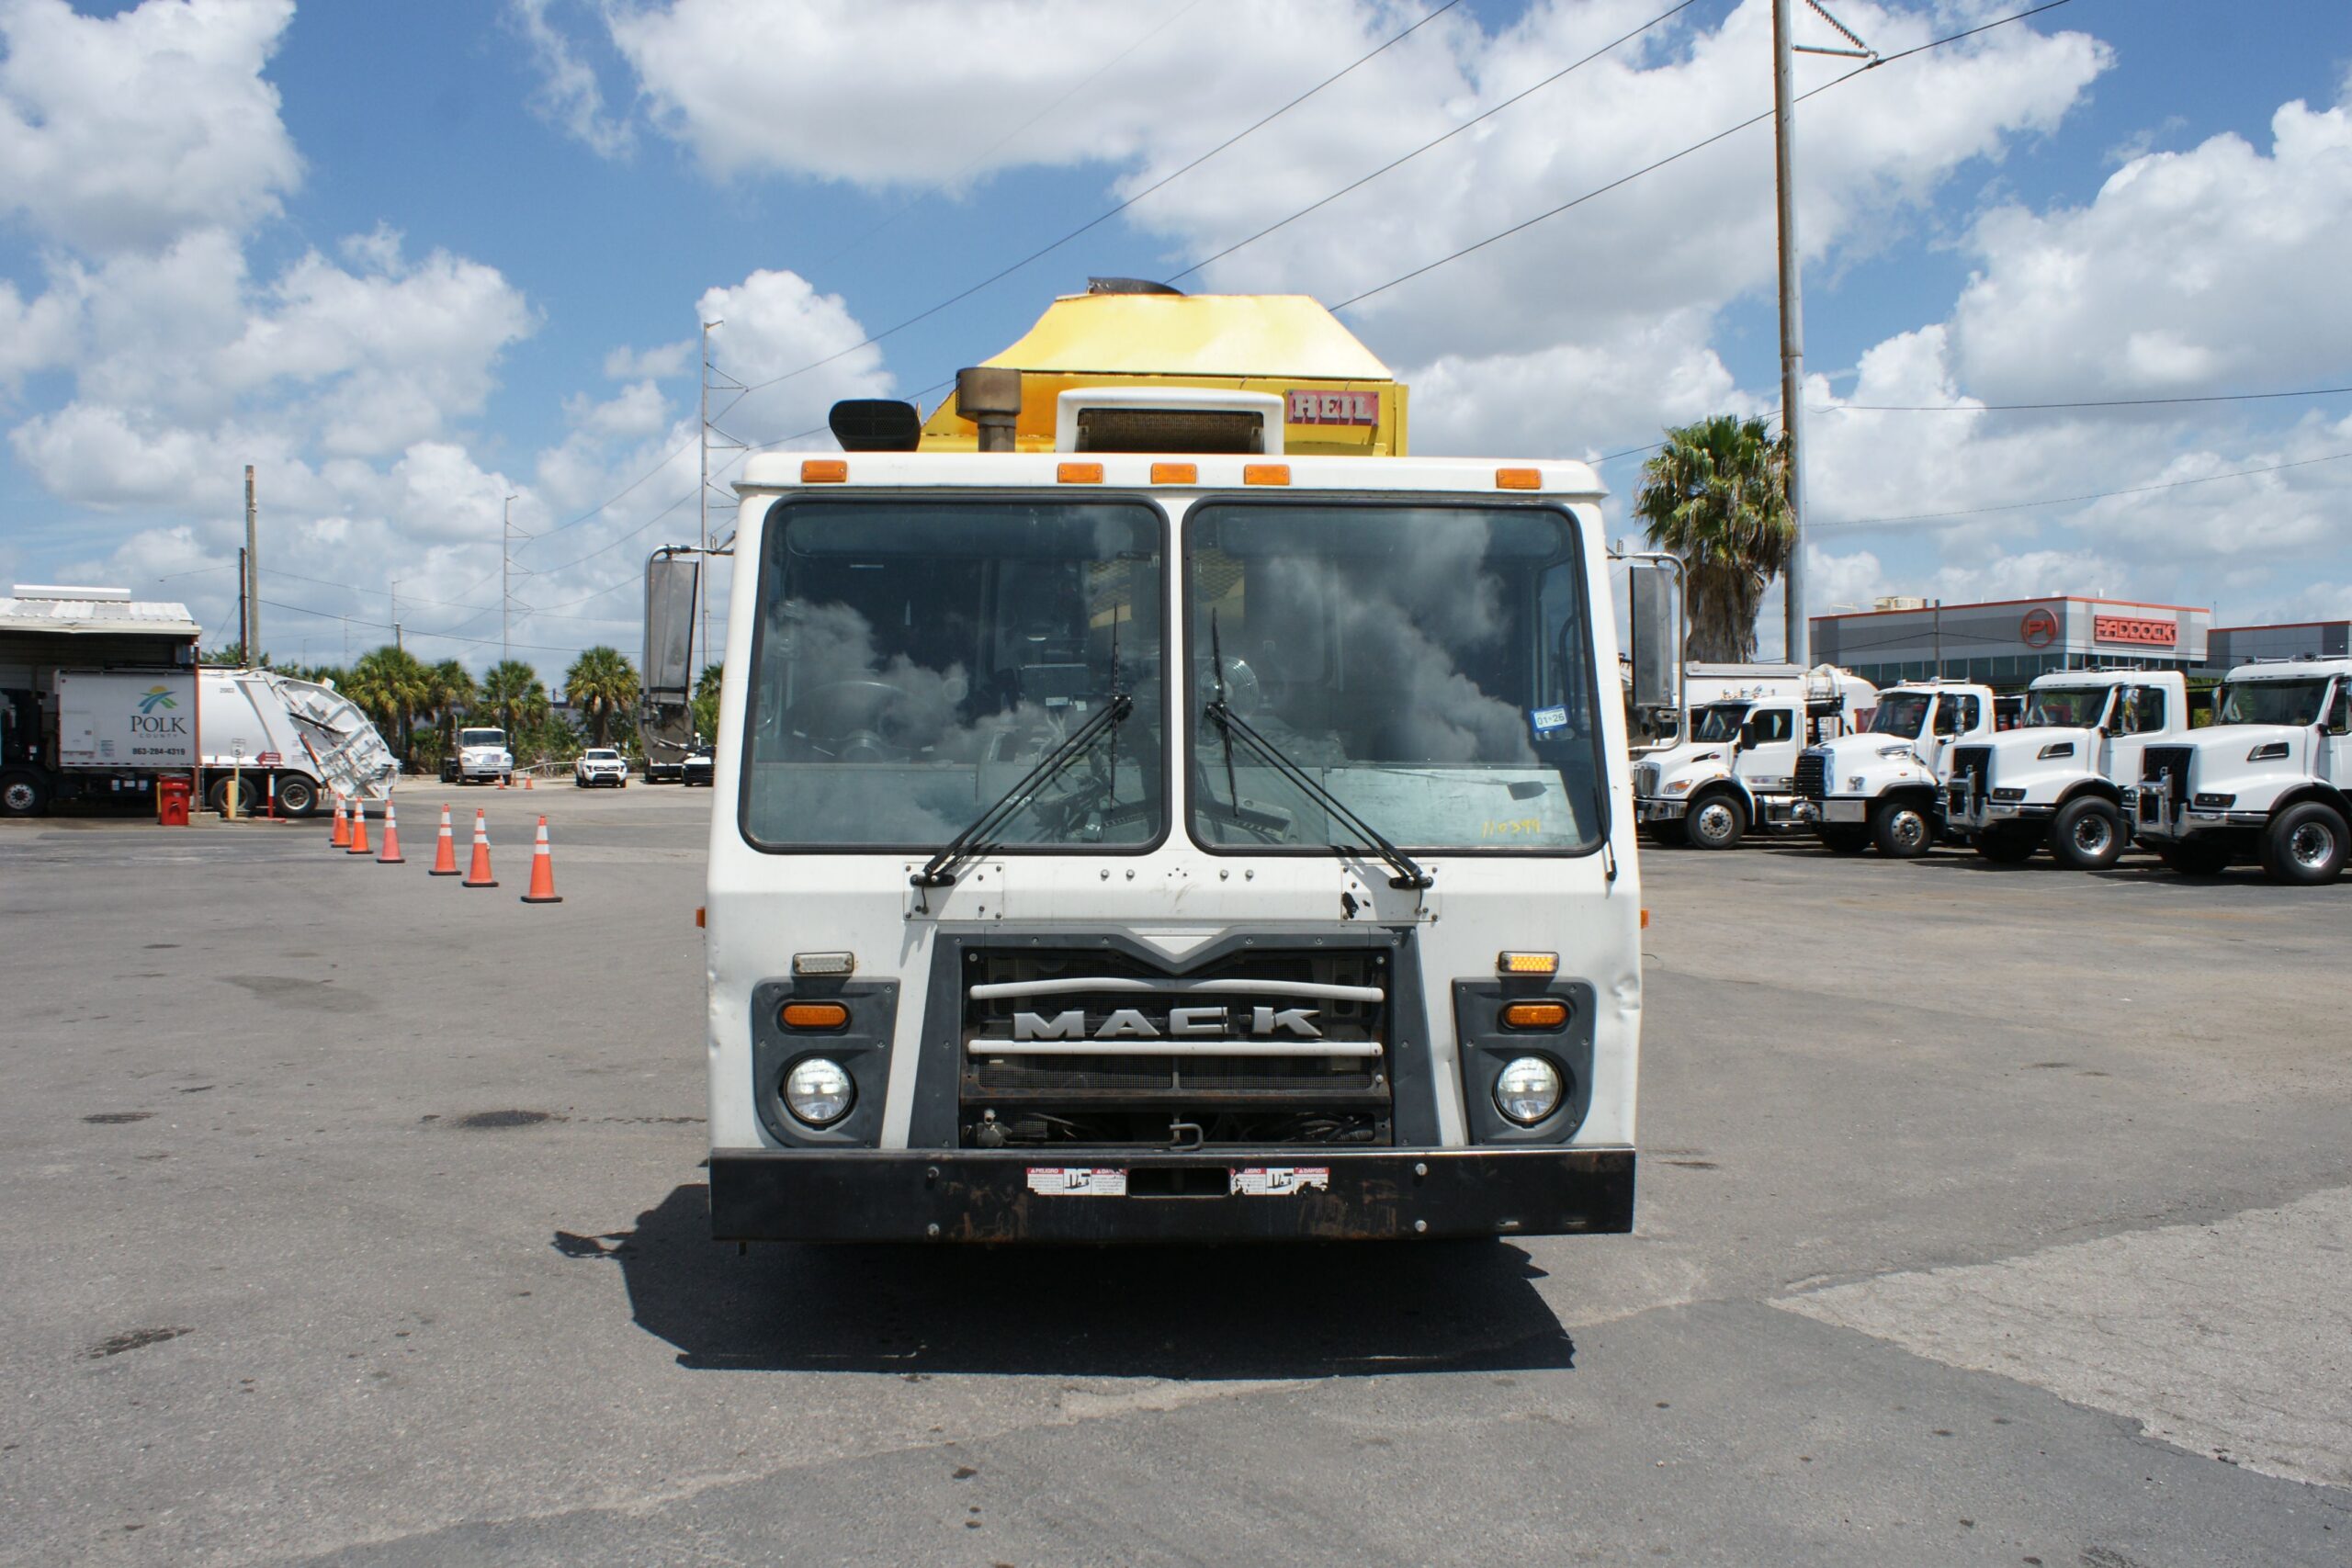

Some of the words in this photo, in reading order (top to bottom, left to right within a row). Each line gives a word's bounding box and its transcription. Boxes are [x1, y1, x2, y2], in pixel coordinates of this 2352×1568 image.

[1294, 394, 1373, 420] HEIL
[2028, 620, 2054, 637] P1
[130, 716, 187, 734] POLK
[1013, 1006, 1323, 1039] MACK
